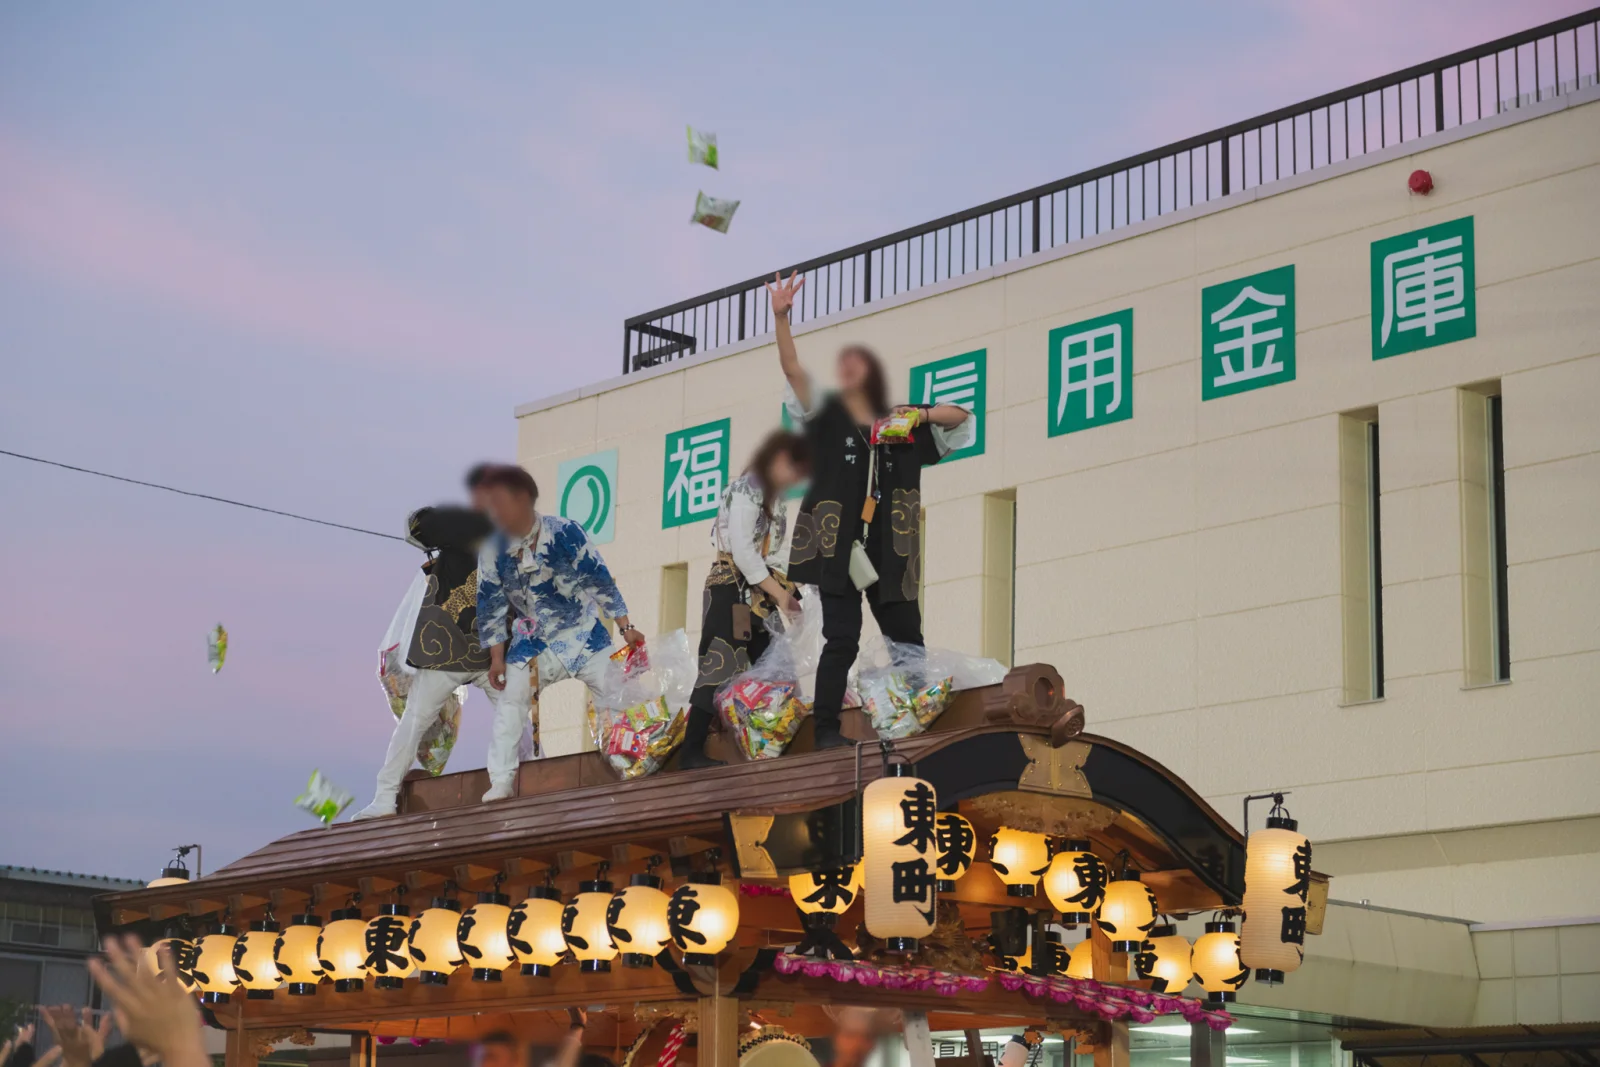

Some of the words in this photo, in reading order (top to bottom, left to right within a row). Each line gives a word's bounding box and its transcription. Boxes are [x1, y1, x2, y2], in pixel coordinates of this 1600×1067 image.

[667, 236, 1465, 518] 福信用金庫
[845, 437, 856, 464] 東町
[893, 782, 936, 926] 東町
[936, 815, 973, 875] 東
[1064, 853, 1107, 909] 東
[365, 917, 408, 974] 東
